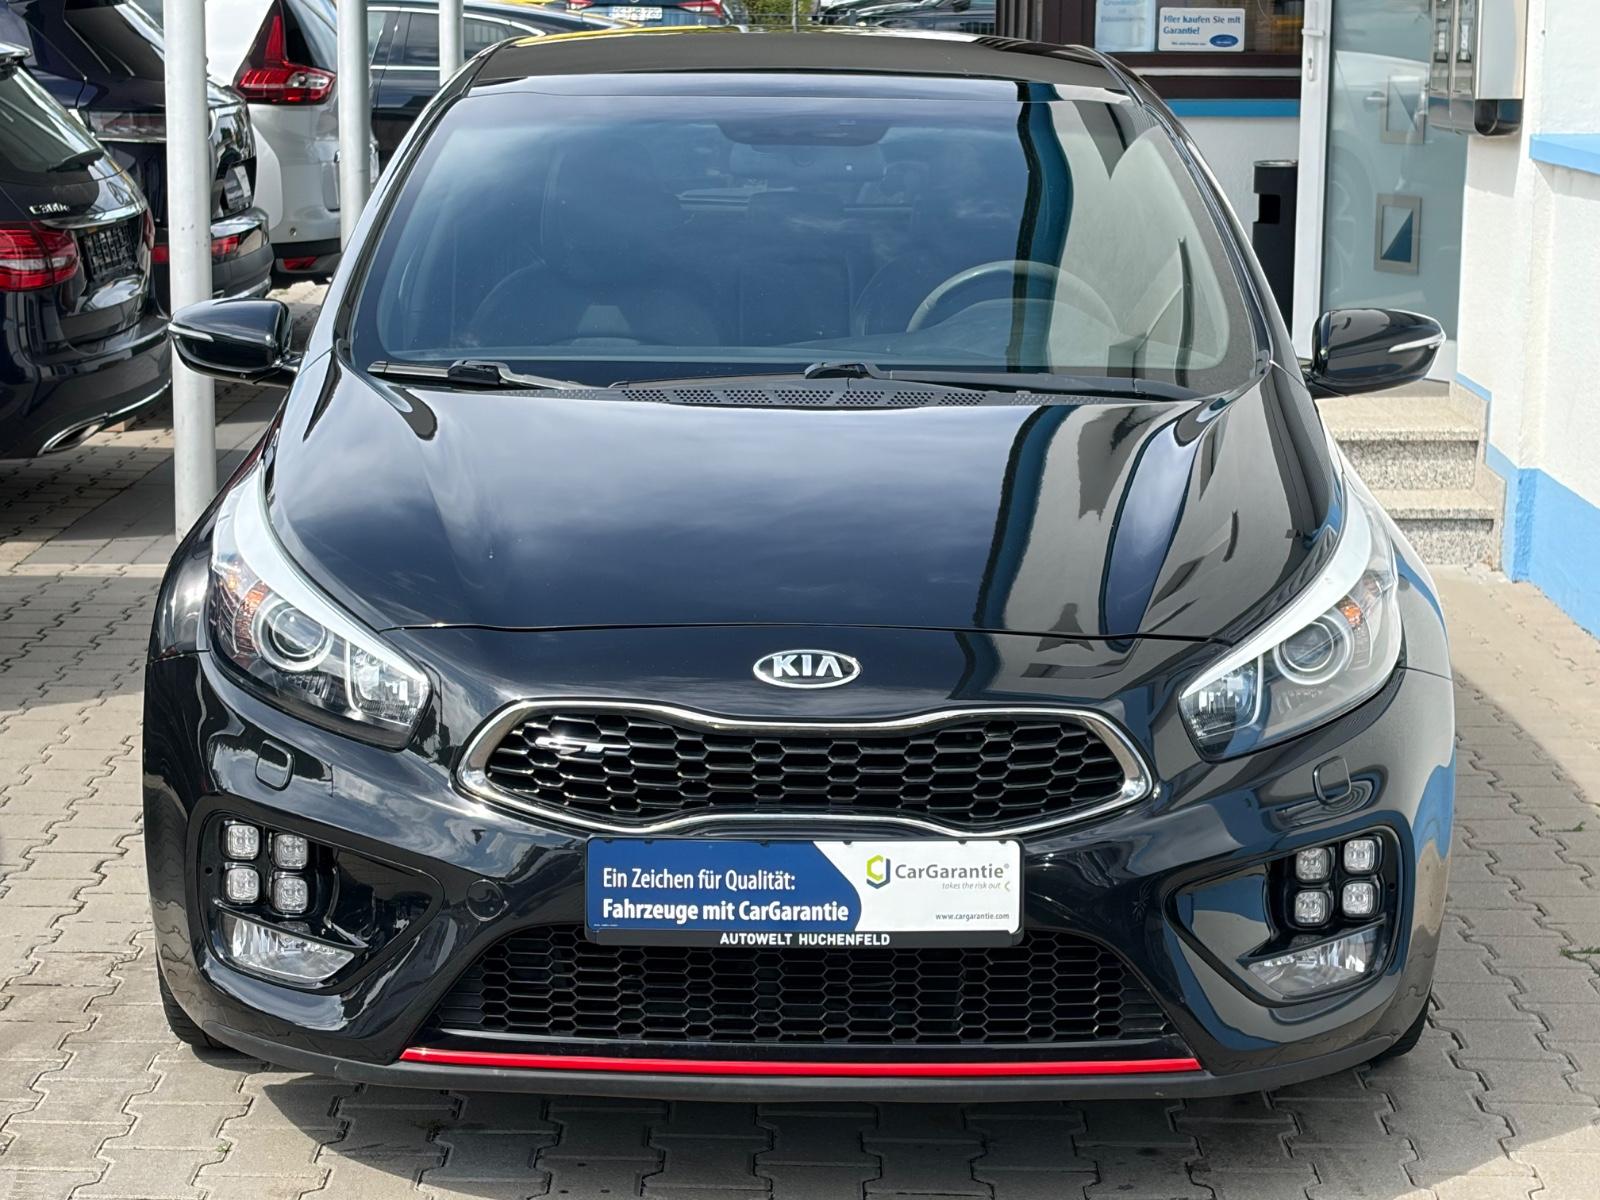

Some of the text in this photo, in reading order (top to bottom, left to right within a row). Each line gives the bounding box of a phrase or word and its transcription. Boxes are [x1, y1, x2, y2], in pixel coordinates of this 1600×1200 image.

[1163, 15, 1241, 24] Hier kaufen Sie mit
[772, 654, 844, 678] KIA
[603, 868, 796, 890] Ein Zeichen für Qualität:
[942, 881, 1001, 890] takes the risk out
[603, 899, 849, 924] Fahrzeuge mit CarGarantie
[935, 912, 1010, 922] www.cargarantie.com
[720, 933, 891, 946] AUTOWELT HUCHENFELD
